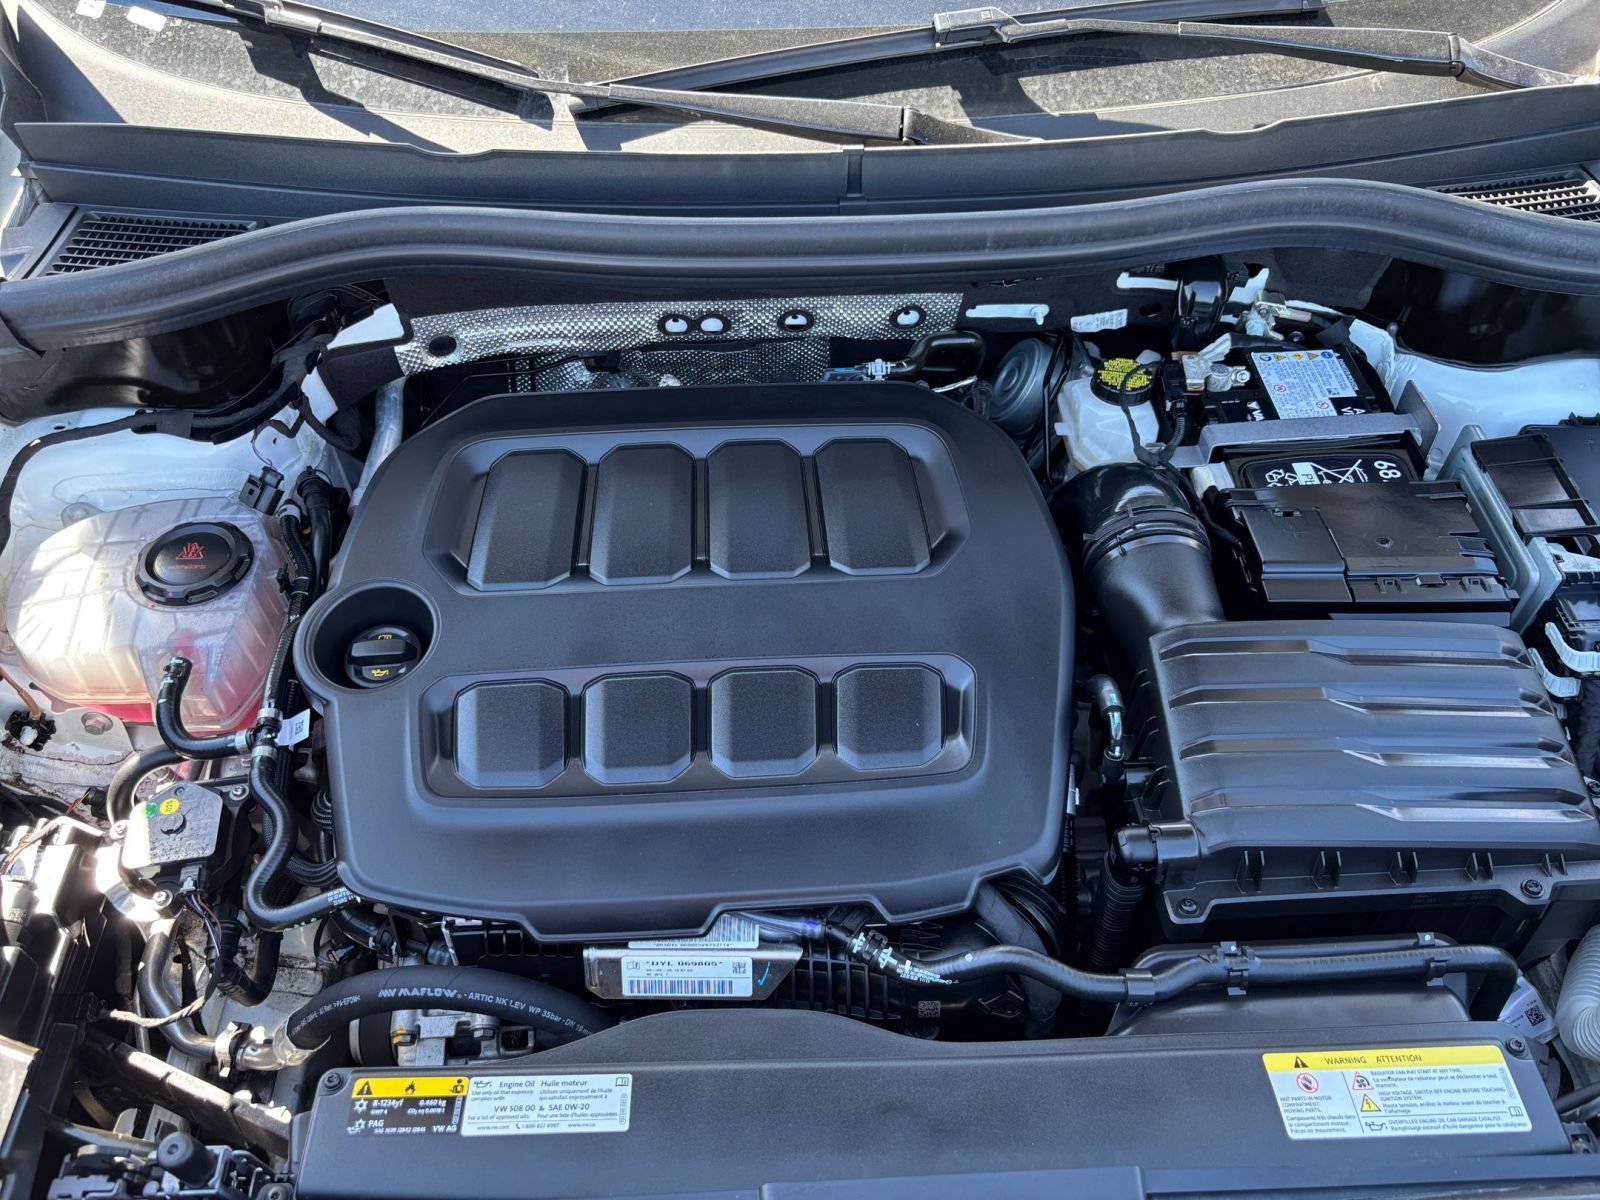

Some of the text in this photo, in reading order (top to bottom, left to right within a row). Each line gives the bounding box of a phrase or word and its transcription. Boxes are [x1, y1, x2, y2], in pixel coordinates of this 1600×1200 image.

[468, 992, 494, 1003] ARTIC
[495, 996, 508, 1006] NK
[509, 999, 526, 1010] LEV
[528, 1005, 541, 1014] WP
[541, 1009, 562, 1023] 35bar
[1324, 1054, 1423, 1065] WARNING ATTENTION
[499, 1081, 523, 1089] Engine
[372, 1098, 404, 1109] R-1234yf
[438, 1099, 447, 1108] kg
[368, 1119, 385, 1128] PAG
[432, 1125, 446, 1133] VW
[446, 1124, 457, 1132] AG
